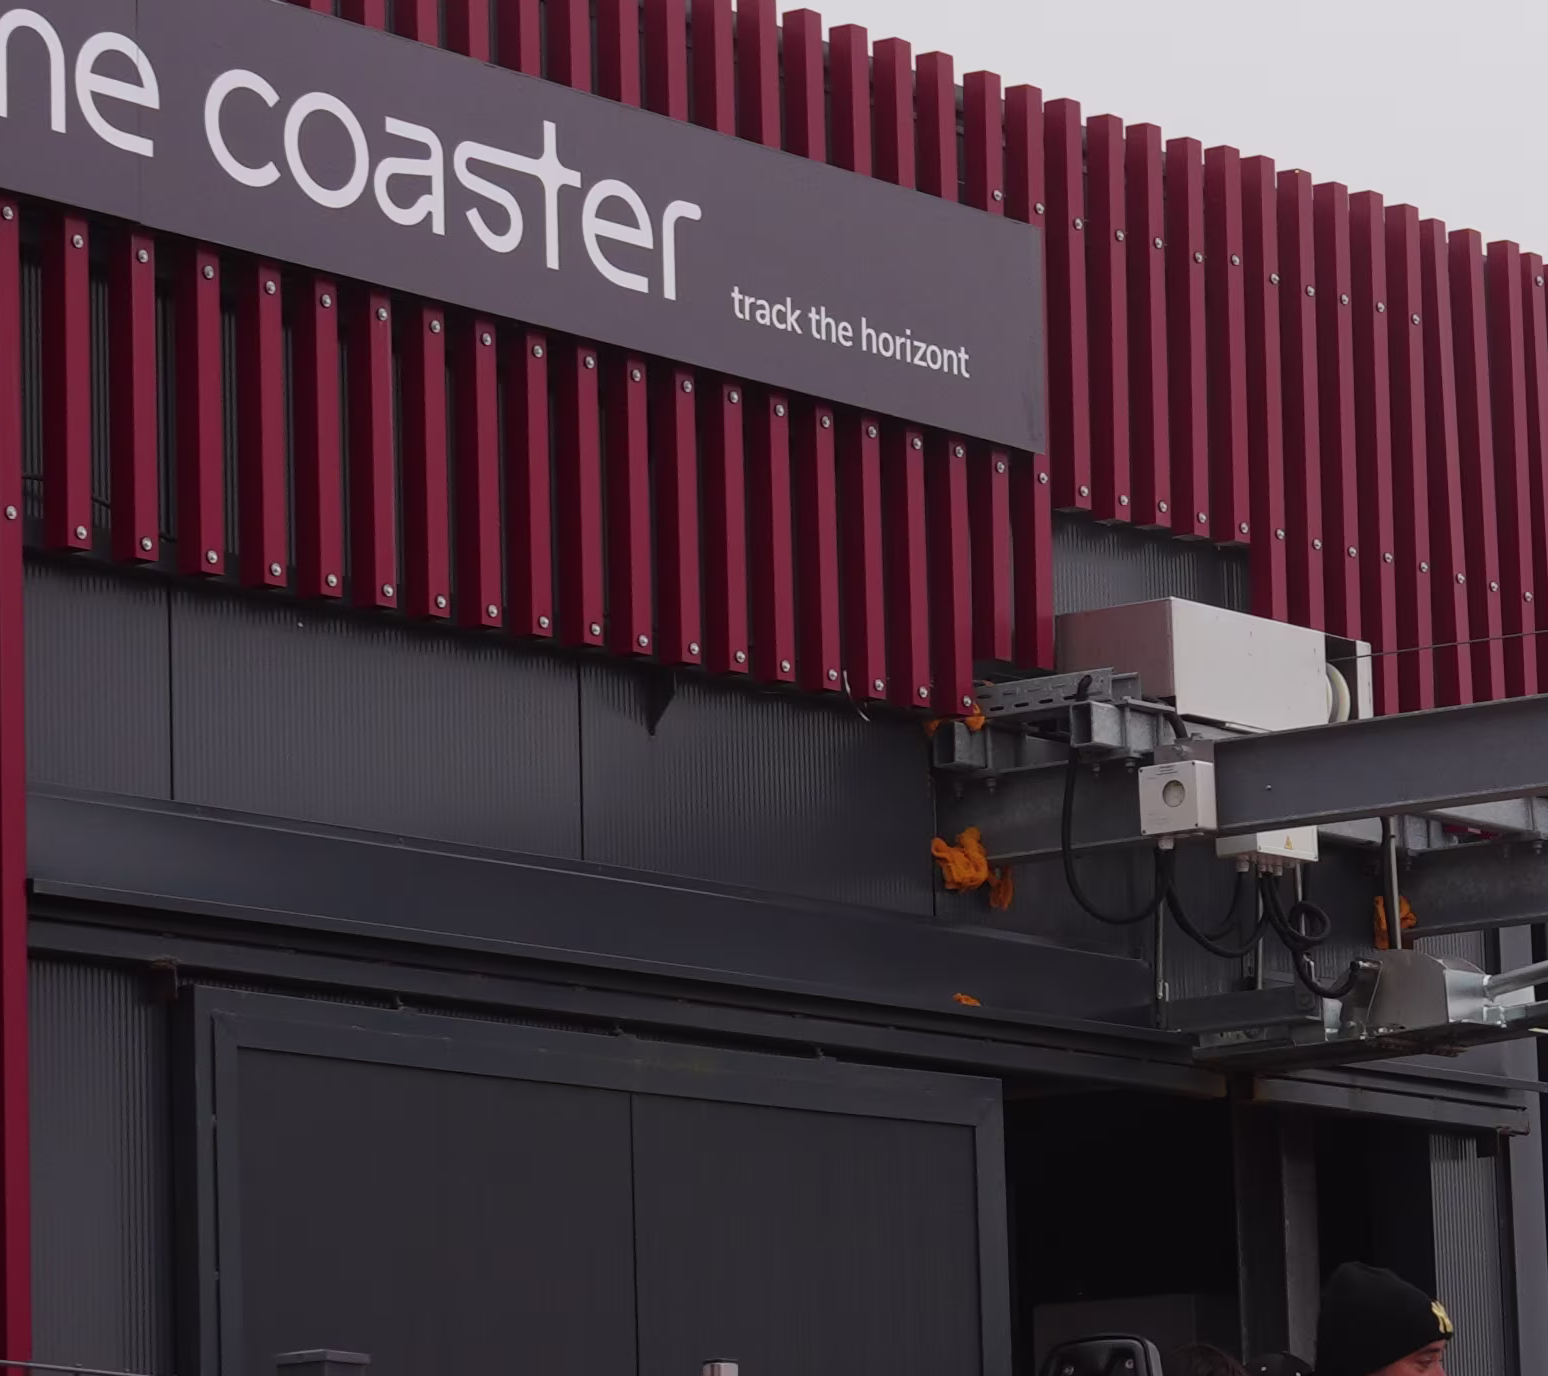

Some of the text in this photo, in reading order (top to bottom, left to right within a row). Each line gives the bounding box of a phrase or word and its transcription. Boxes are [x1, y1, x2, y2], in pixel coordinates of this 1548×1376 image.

[203, 68, 703, 301] coaster
[730, 285, 971, 379] track the horizont
